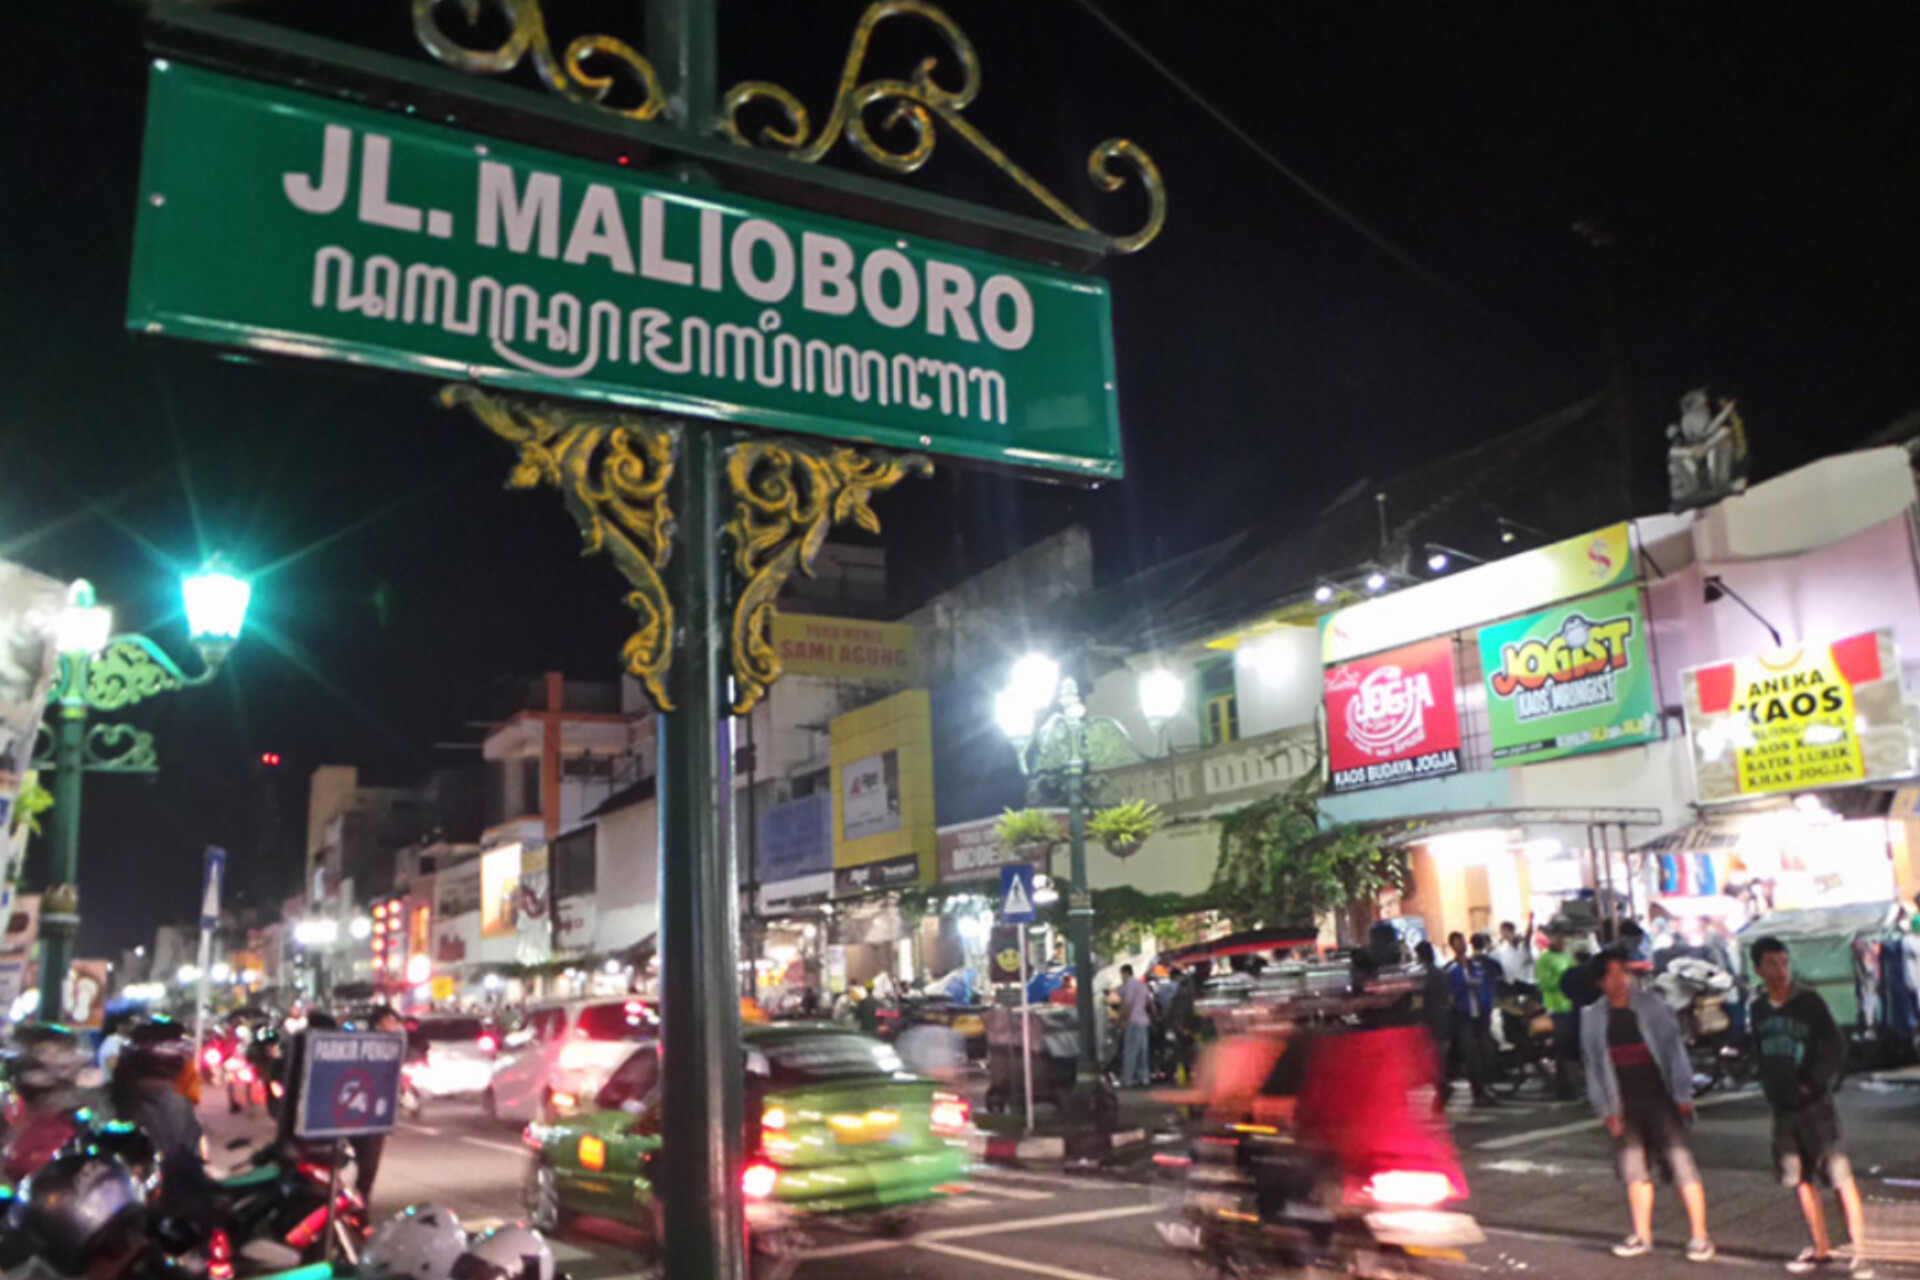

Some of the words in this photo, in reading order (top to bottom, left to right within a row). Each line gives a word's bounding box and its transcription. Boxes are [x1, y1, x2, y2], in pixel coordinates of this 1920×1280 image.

[283, 123, 452, 239] JL.
[476, 160, 1034, 350] MALIOBORO
[781, 640, 834, 664] SAMI
[840, 644, 907, 667] AGUNG
[1491, 616, 1633, 697] JOGIST
[1748, 669, 1825, 698] ANEKA
[1745, 738, 1792, 757] KAOS
[1746, 751, 1793, 773] BATIK
[1800, 746, 1851, 766] LURIK
[1334, 766, 1366, 787] KAOS
[1367, 758, 1415, 782] BUDAYA
[1415, 749, 1459, 773] JOGJA
[1747, 769, 1793, 788] KHAS
[1799, 763, 1853, 781] JOGJA
[314, 1039, 359, 1061] PARKIR
